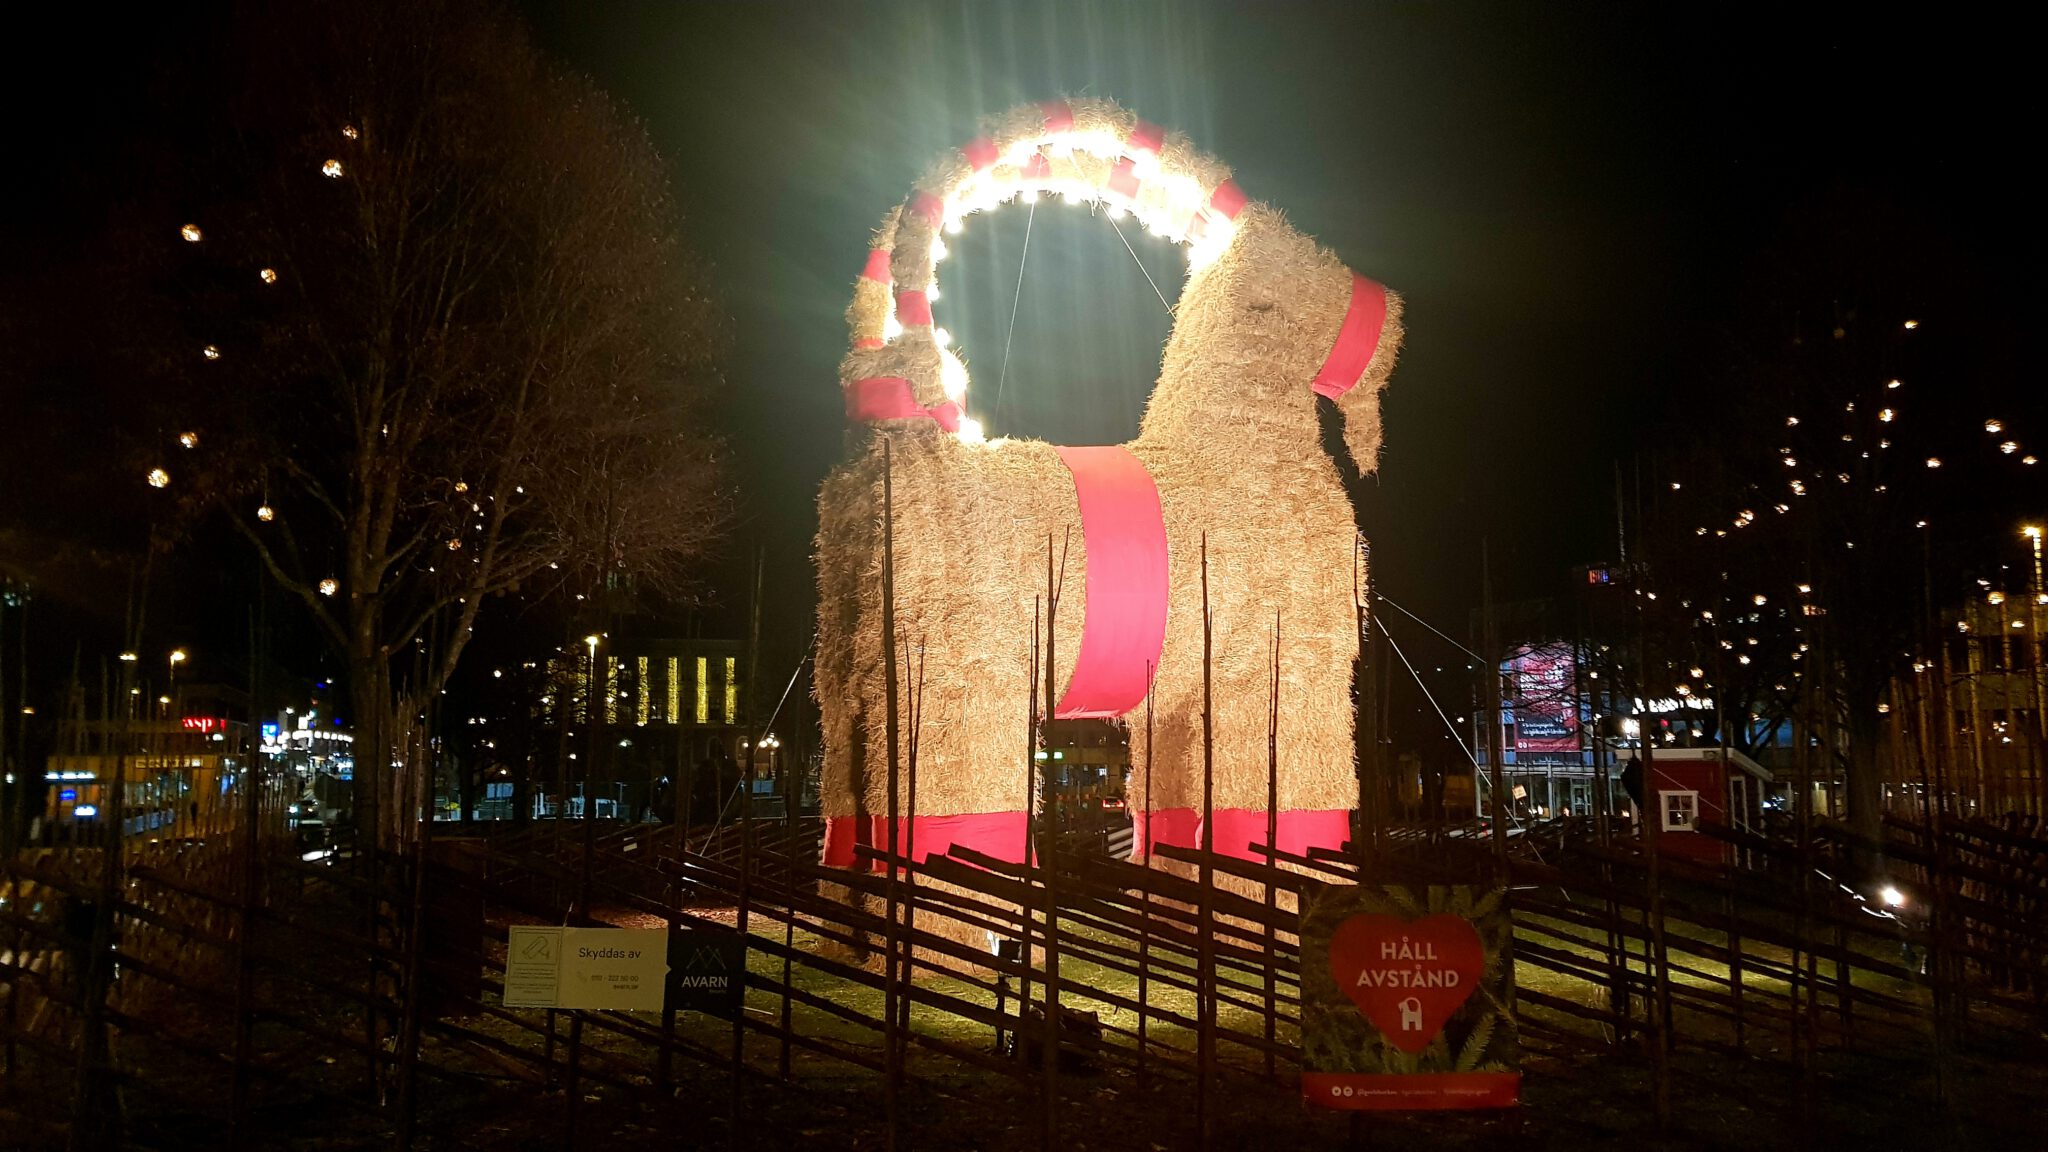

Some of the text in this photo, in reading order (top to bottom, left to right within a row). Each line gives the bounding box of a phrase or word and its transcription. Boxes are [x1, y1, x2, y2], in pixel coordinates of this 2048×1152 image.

[578, 947, 641, 960] Skyddas av
[1381, 936, 1438, 960] HÅLL
[681, 975, 728, 988] AVARN
[1356, 964, 1459, 988] AVSTÅND
